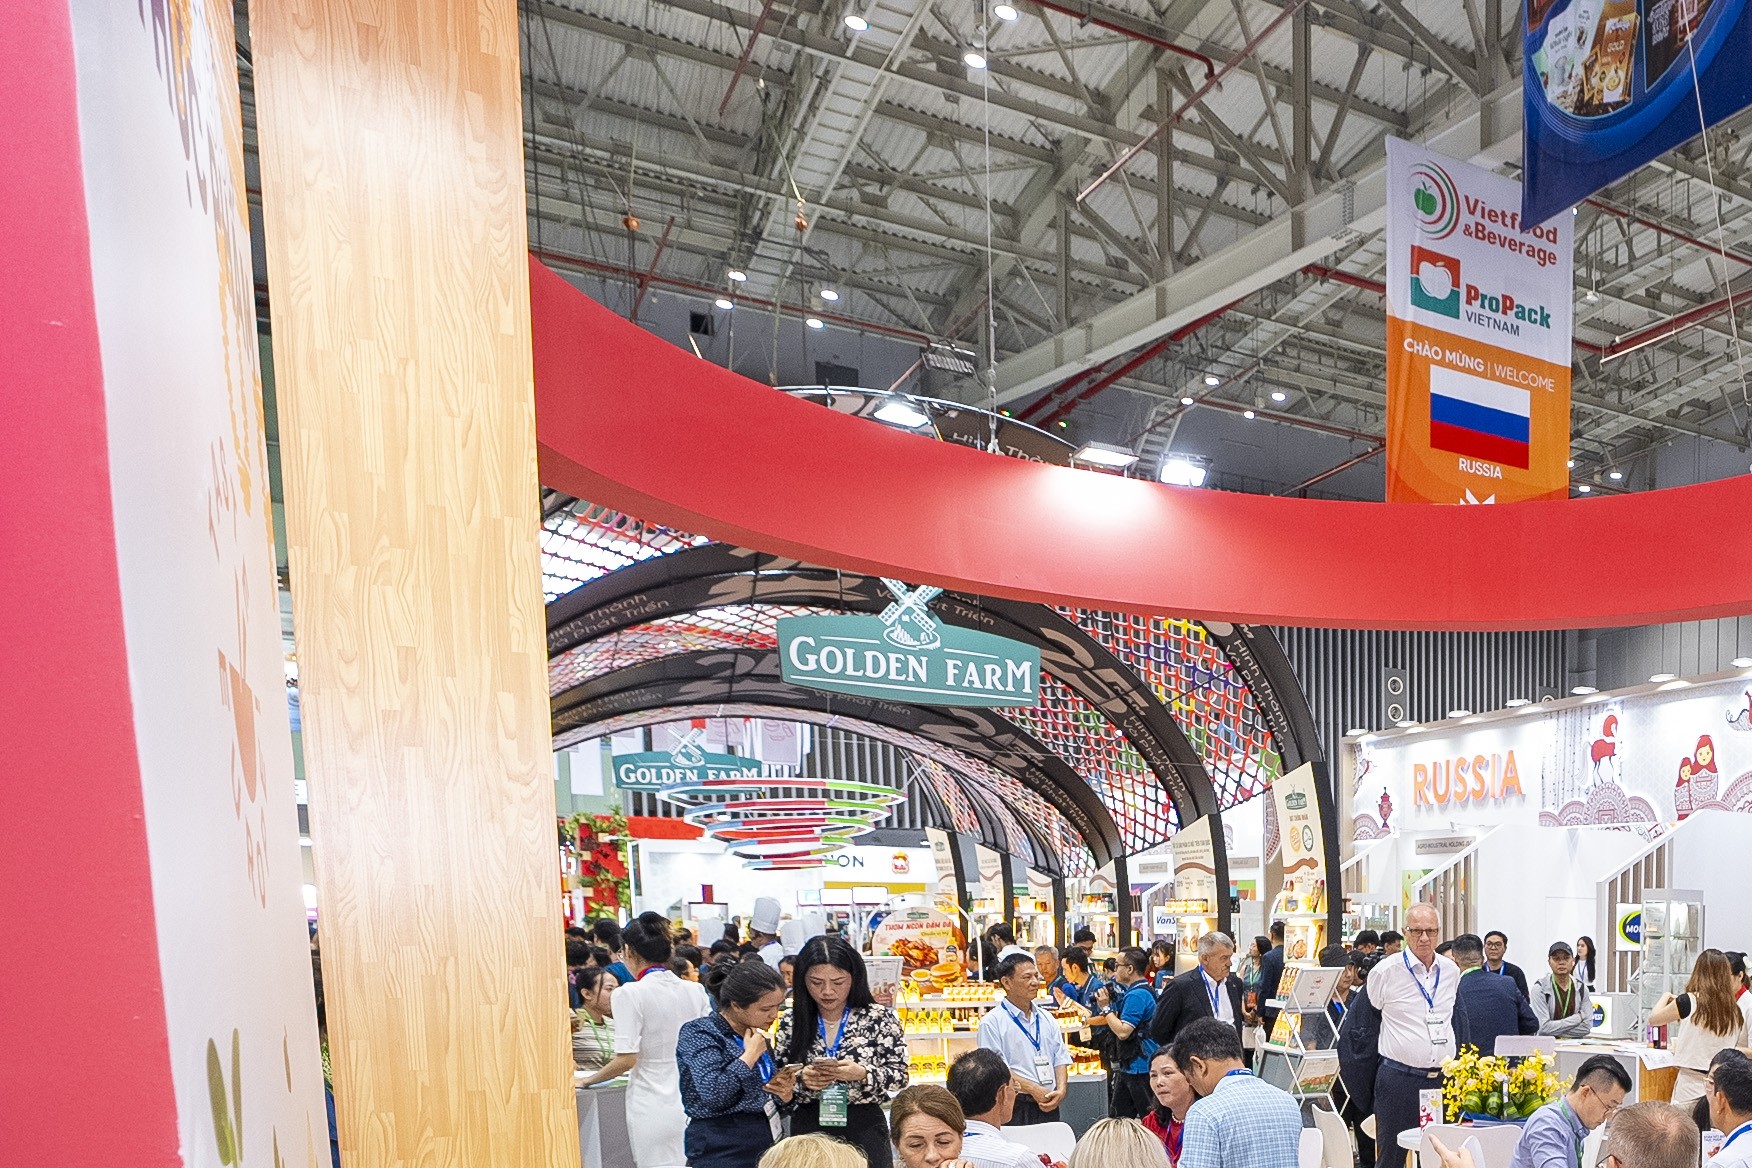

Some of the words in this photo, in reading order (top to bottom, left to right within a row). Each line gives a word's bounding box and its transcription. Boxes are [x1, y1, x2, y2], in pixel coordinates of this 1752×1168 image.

[1463, 194, 1558, 245] Vietfod
[1463, 221, 1557, 267] &Beverage
[1465, 310, 1520, 337] VIETNAM
[1466, 283, 1551, 329] ProPack
[1403, 338, 1442, 360] CHÀO
[1494, 363, 1555, 392] WELCOME
[1458, 457, 1503, 479] RUSSIA
[789, 636, 928, 683] GOLDEN
[945, 658, 1033, 693] FARM
[1413, 749, 1525, 807] RUSSIA
